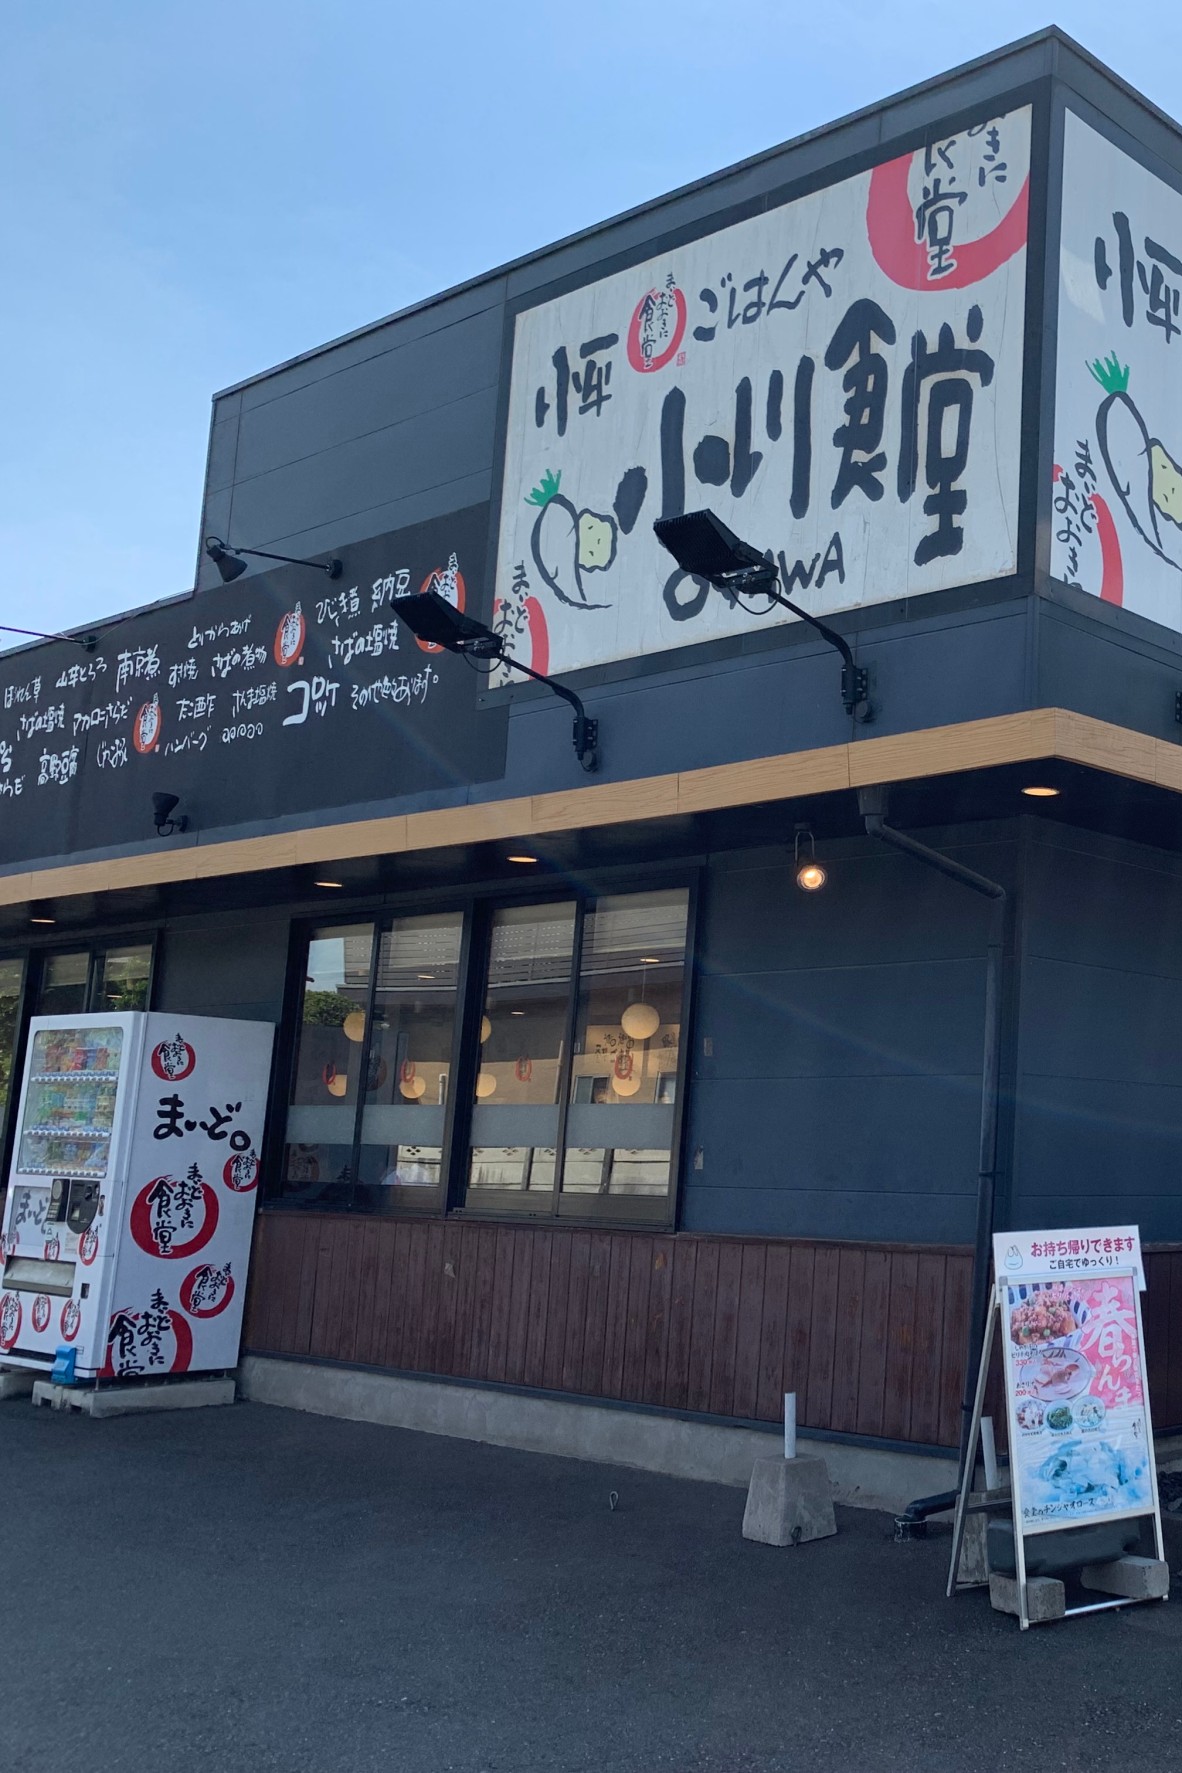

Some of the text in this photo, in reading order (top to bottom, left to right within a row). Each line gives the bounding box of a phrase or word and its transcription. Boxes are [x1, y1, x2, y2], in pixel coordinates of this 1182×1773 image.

[693, 248, 844, 342] ごはんや
[639, 294, 656, 368] 食堂
[614, 298, 995, 567] 小川食堂
[371, 569, 411, 612] 納豆
[663, 532, 846, 622] OWA
[187, 614, 252, 649] とりからあげ
[328, 619, 400, 669] さばの塩焼
[116, 644, 161, 692] 南京煮
[211, 643, 267, 678] さばの煮物
[282, 676, 340, 726] コロッケ
[37, 745, 80, 786] 高野豆腐
[164, 725, 212, 756] ハンバーグ
[153, 1094, 251, 1151] まいど。
[148, 1179, 176, 1253] 食堂
[1031, 1236, 1135, 1257] お持ち帰りできます
